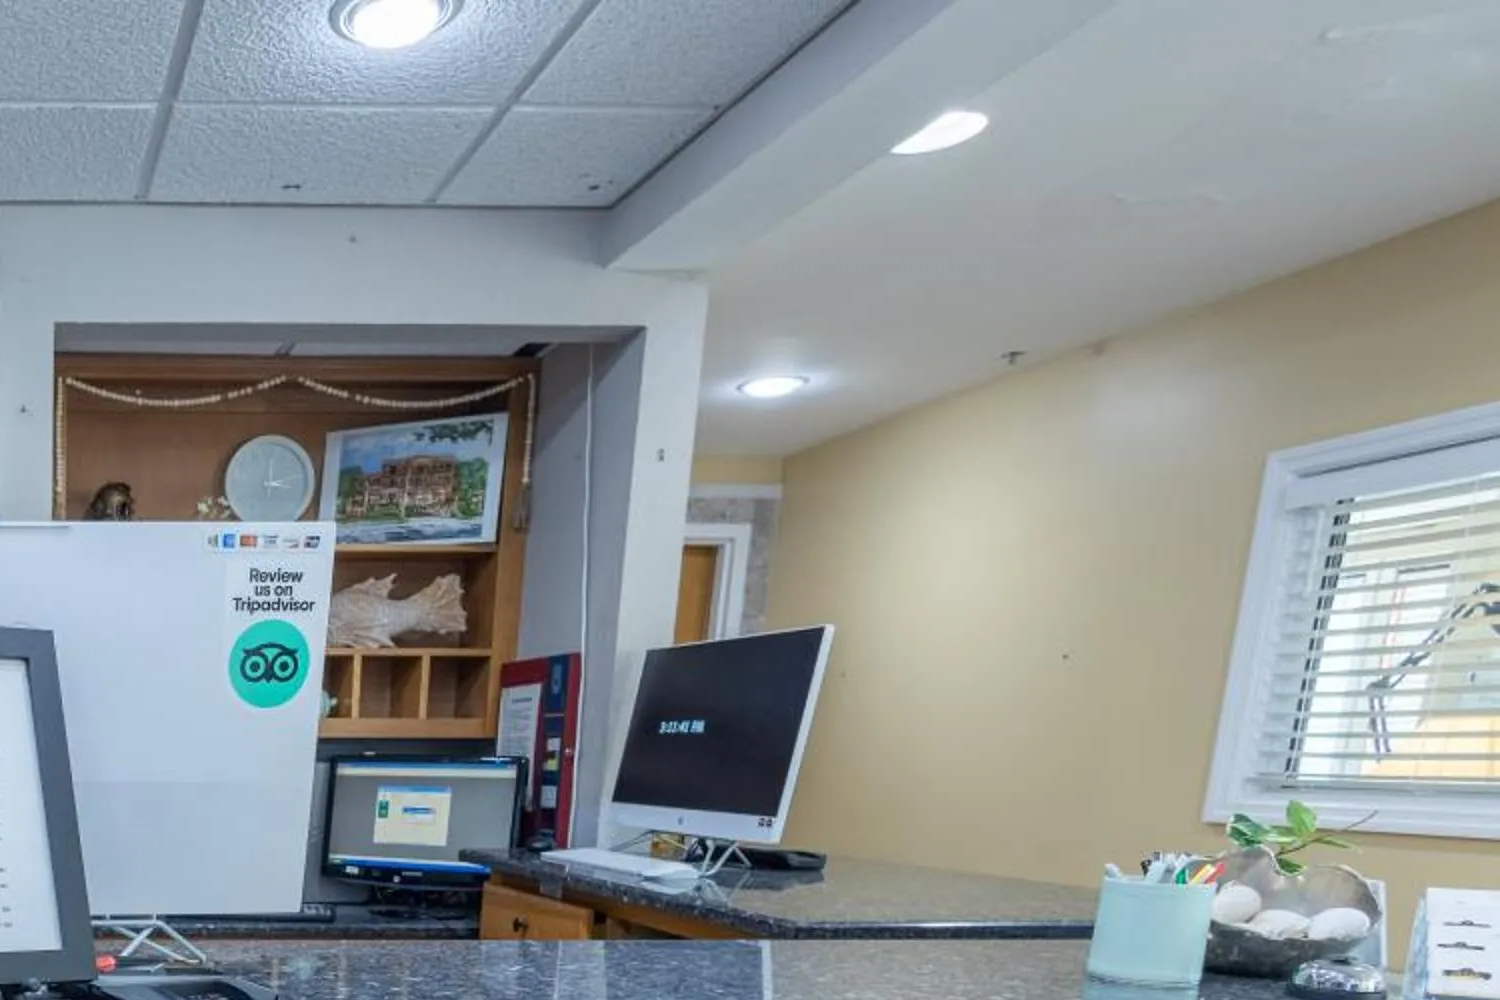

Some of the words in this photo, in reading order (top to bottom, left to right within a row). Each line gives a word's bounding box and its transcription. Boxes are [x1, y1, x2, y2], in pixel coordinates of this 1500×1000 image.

[249, 568, 304, 583] Review
[255, 585, 271, 597] us
[273, 585, 293, 597] on
[232, 596, 316, 614] Tripadvisor
